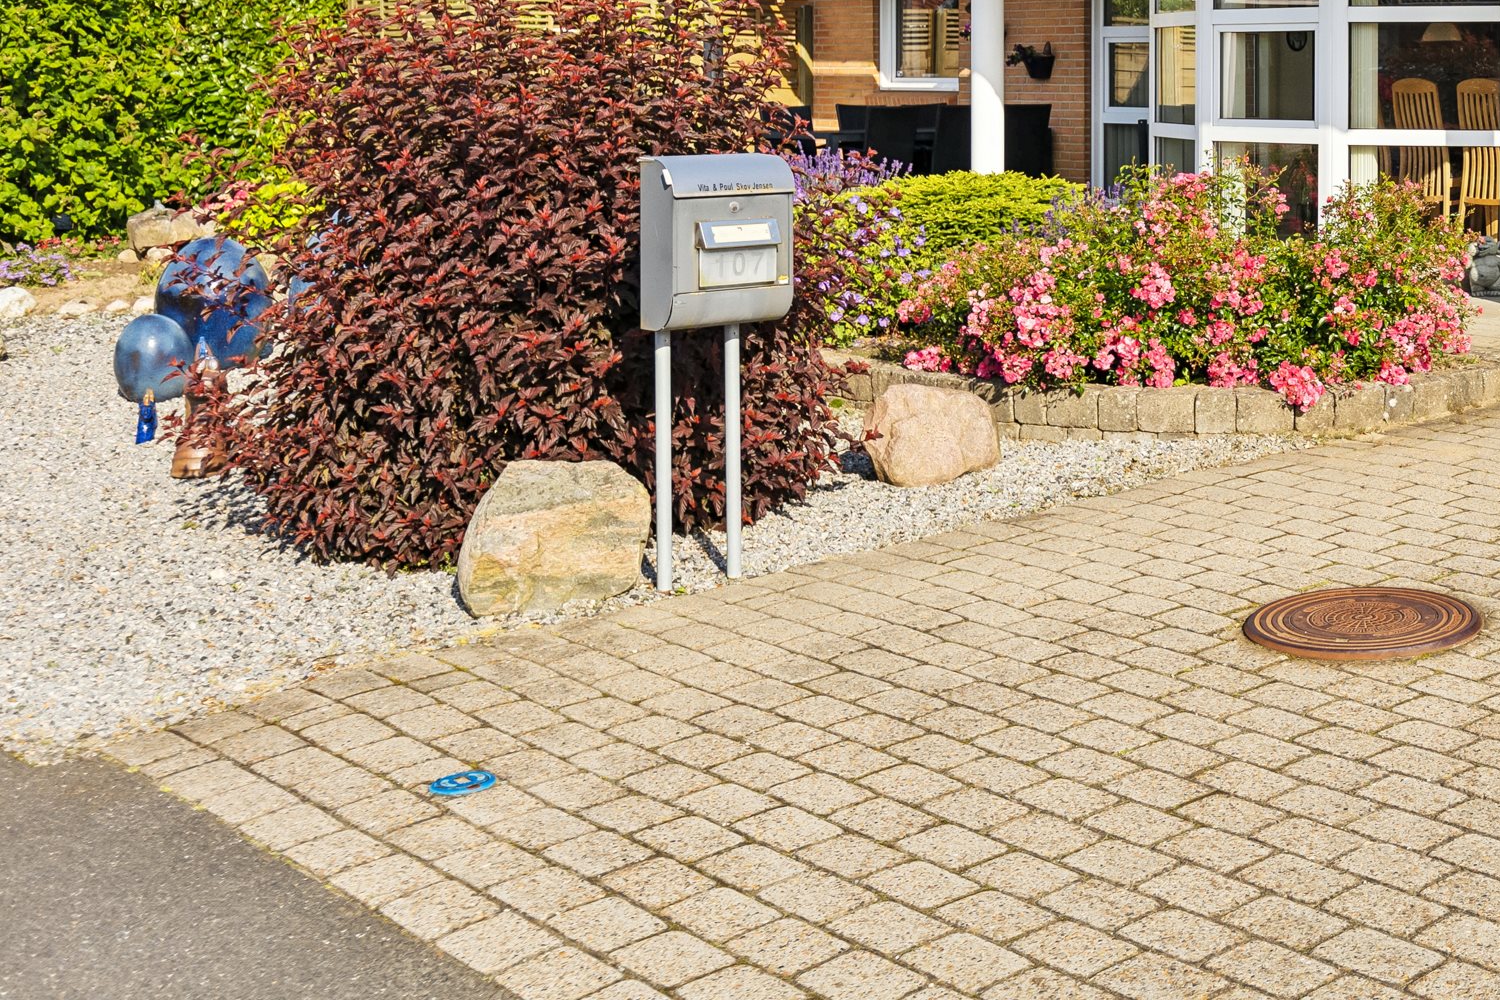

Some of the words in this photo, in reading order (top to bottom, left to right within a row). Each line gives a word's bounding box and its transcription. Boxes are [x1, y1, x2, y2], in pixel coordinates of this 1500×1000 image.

[698, 184, 710, 192] Vita
[712, 183, 718, 192] &
[719, 182, 734, 191] Poul
[752, 182, 774, 190] Jensen
[715, 251, 765, 278] 107
